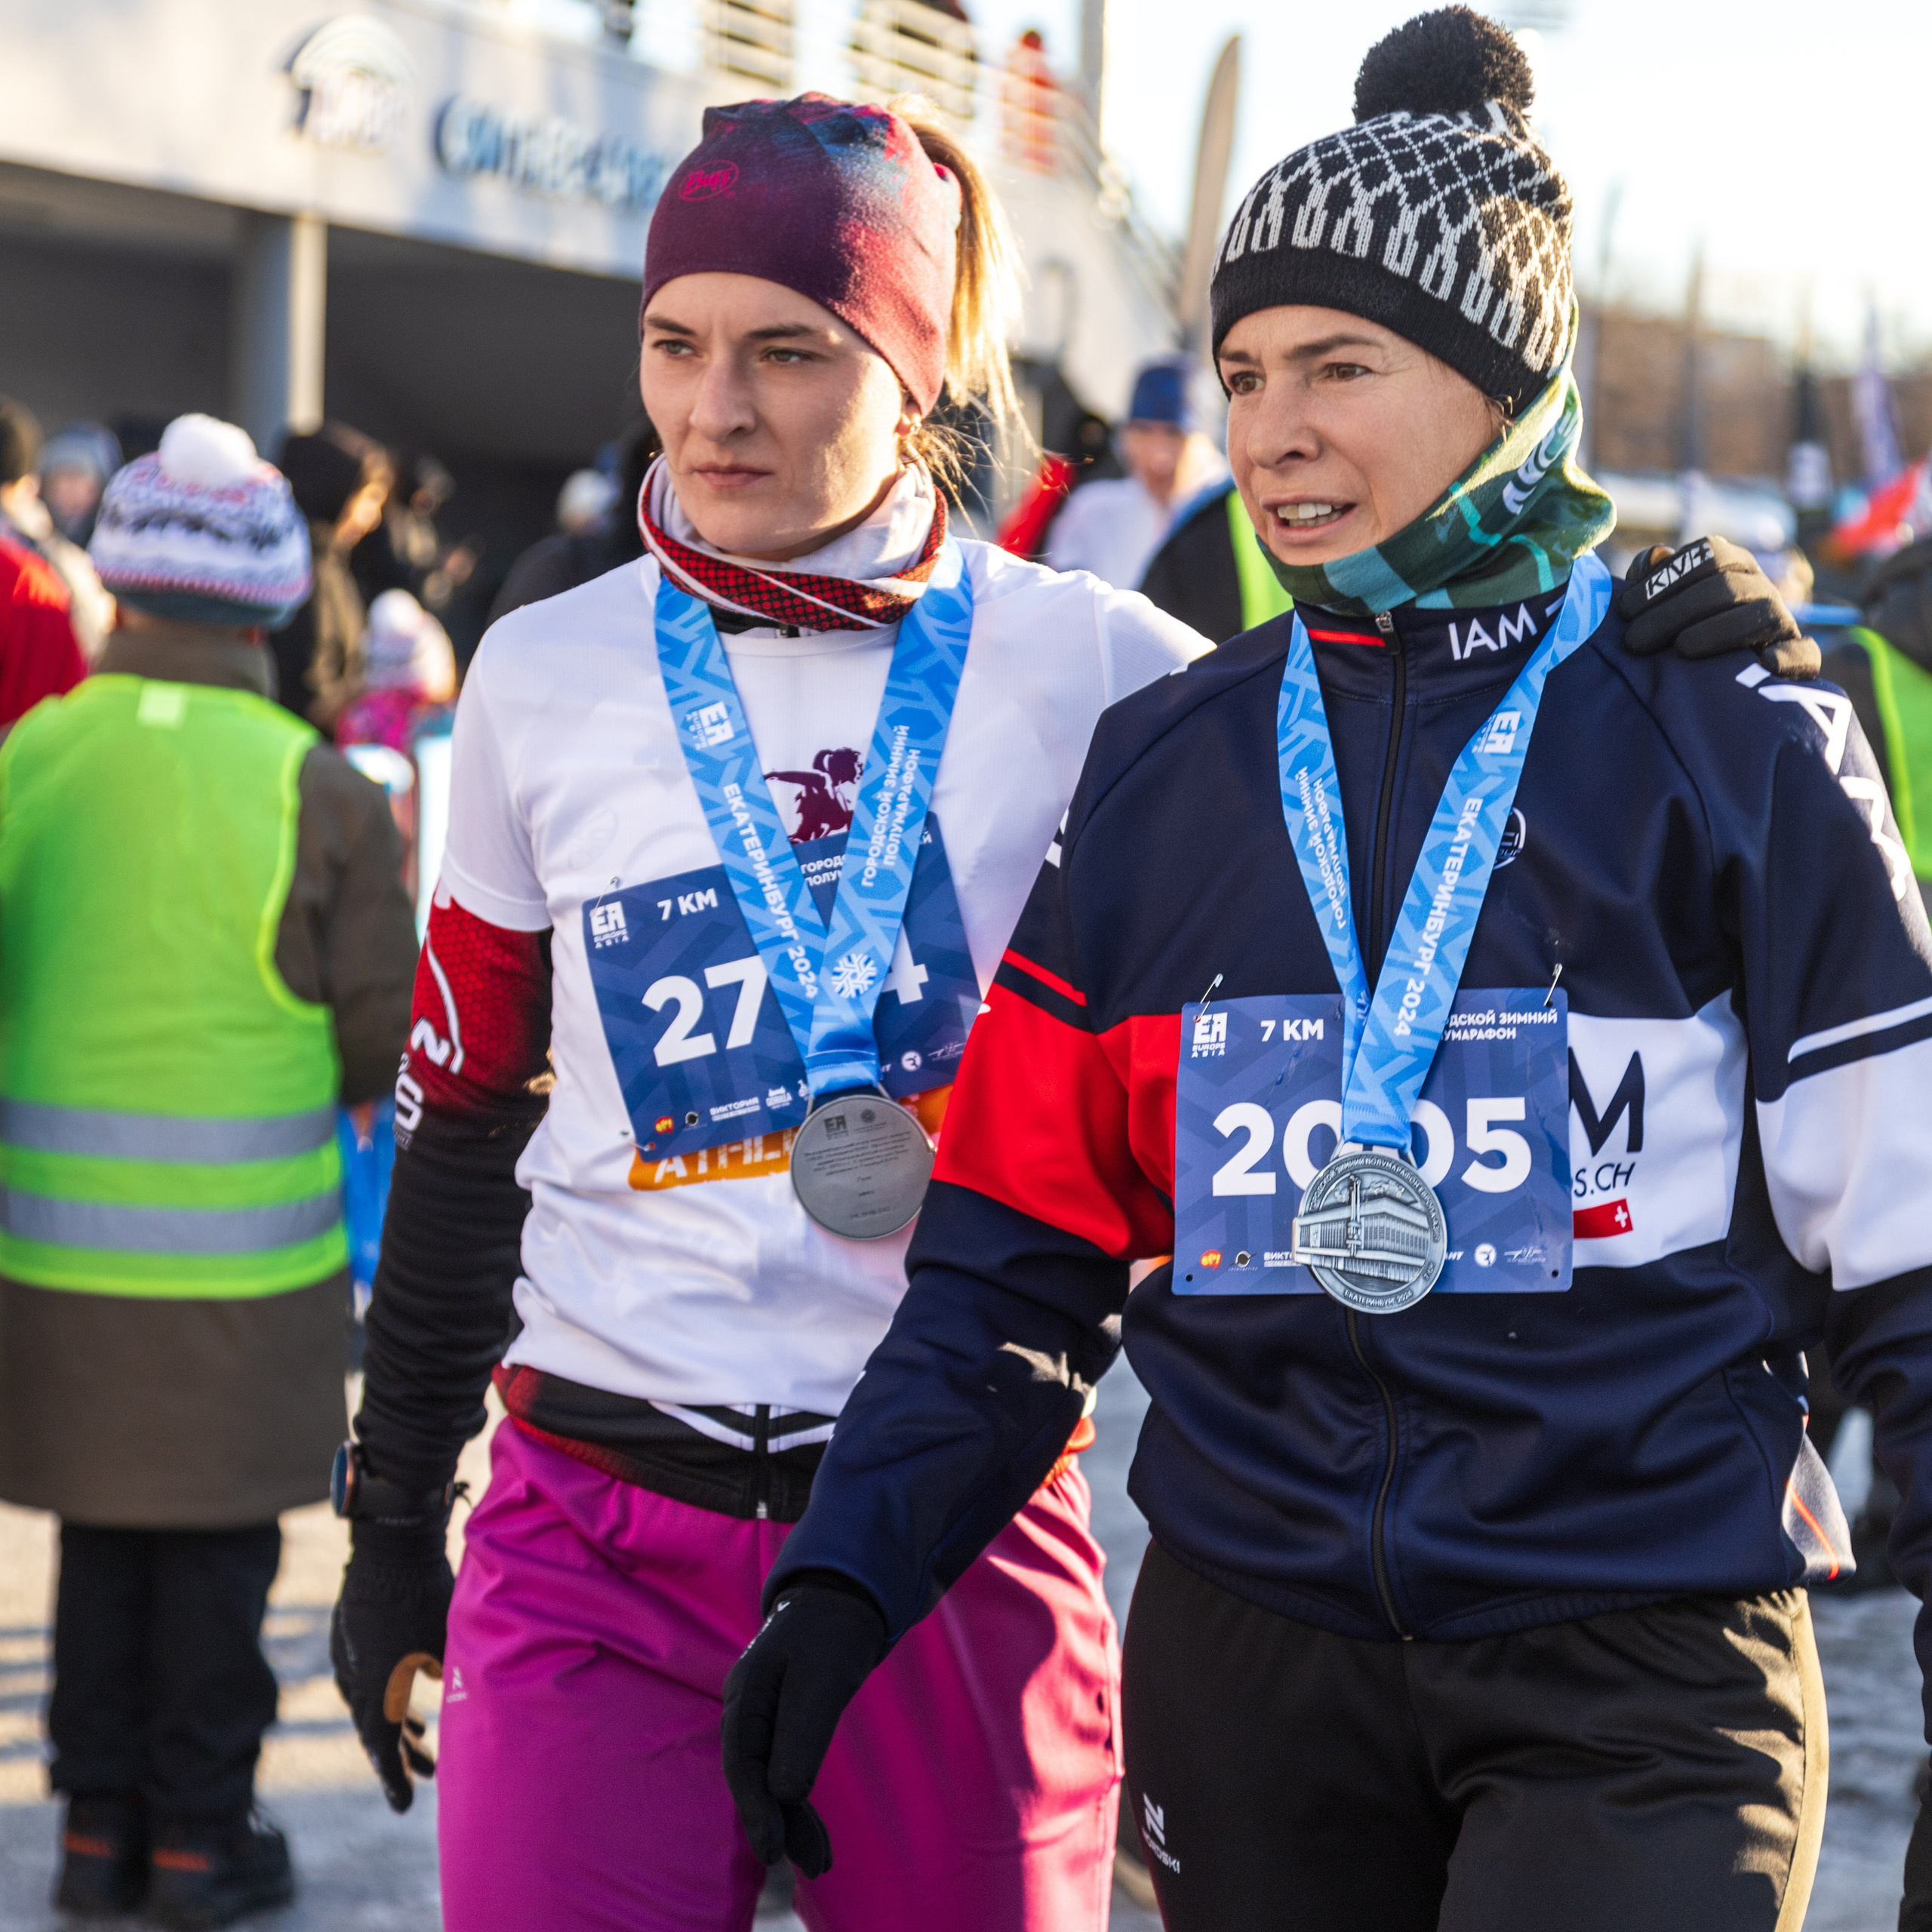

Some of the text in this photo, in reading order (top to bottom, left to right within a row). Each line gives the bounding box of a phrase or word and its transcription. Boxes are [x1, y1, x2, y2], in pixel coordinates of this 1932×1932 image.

[1448, 602, 1537, 660] IAM
[861, 724, 910, 888] ГОРОДСКОЙ ЗИМНИЙ
[883, 749, 921, 866] ПОЛУМАРАФОН
[1294, 766, 1347, 930] ГОРОДСКОЙ ЗИМНИЙ
[1313, 777, 1346, 898] ПОЛУМАРАФОН
[657, 898, 673, 921] 7
[722, 782, 819, 999] ЕКАТЕРИНБУРГ 2024
[1394, 798, 1484, 1036] ЕКАТЕРИНБУРГ 2024
[1260, 1020, 1277, 1042] 7
[1441, 1027, 1517, 1041] УМАРАФОН
[1445, 1008, 1558, 1028] ДСКОЙ ЗИМНИЙ
